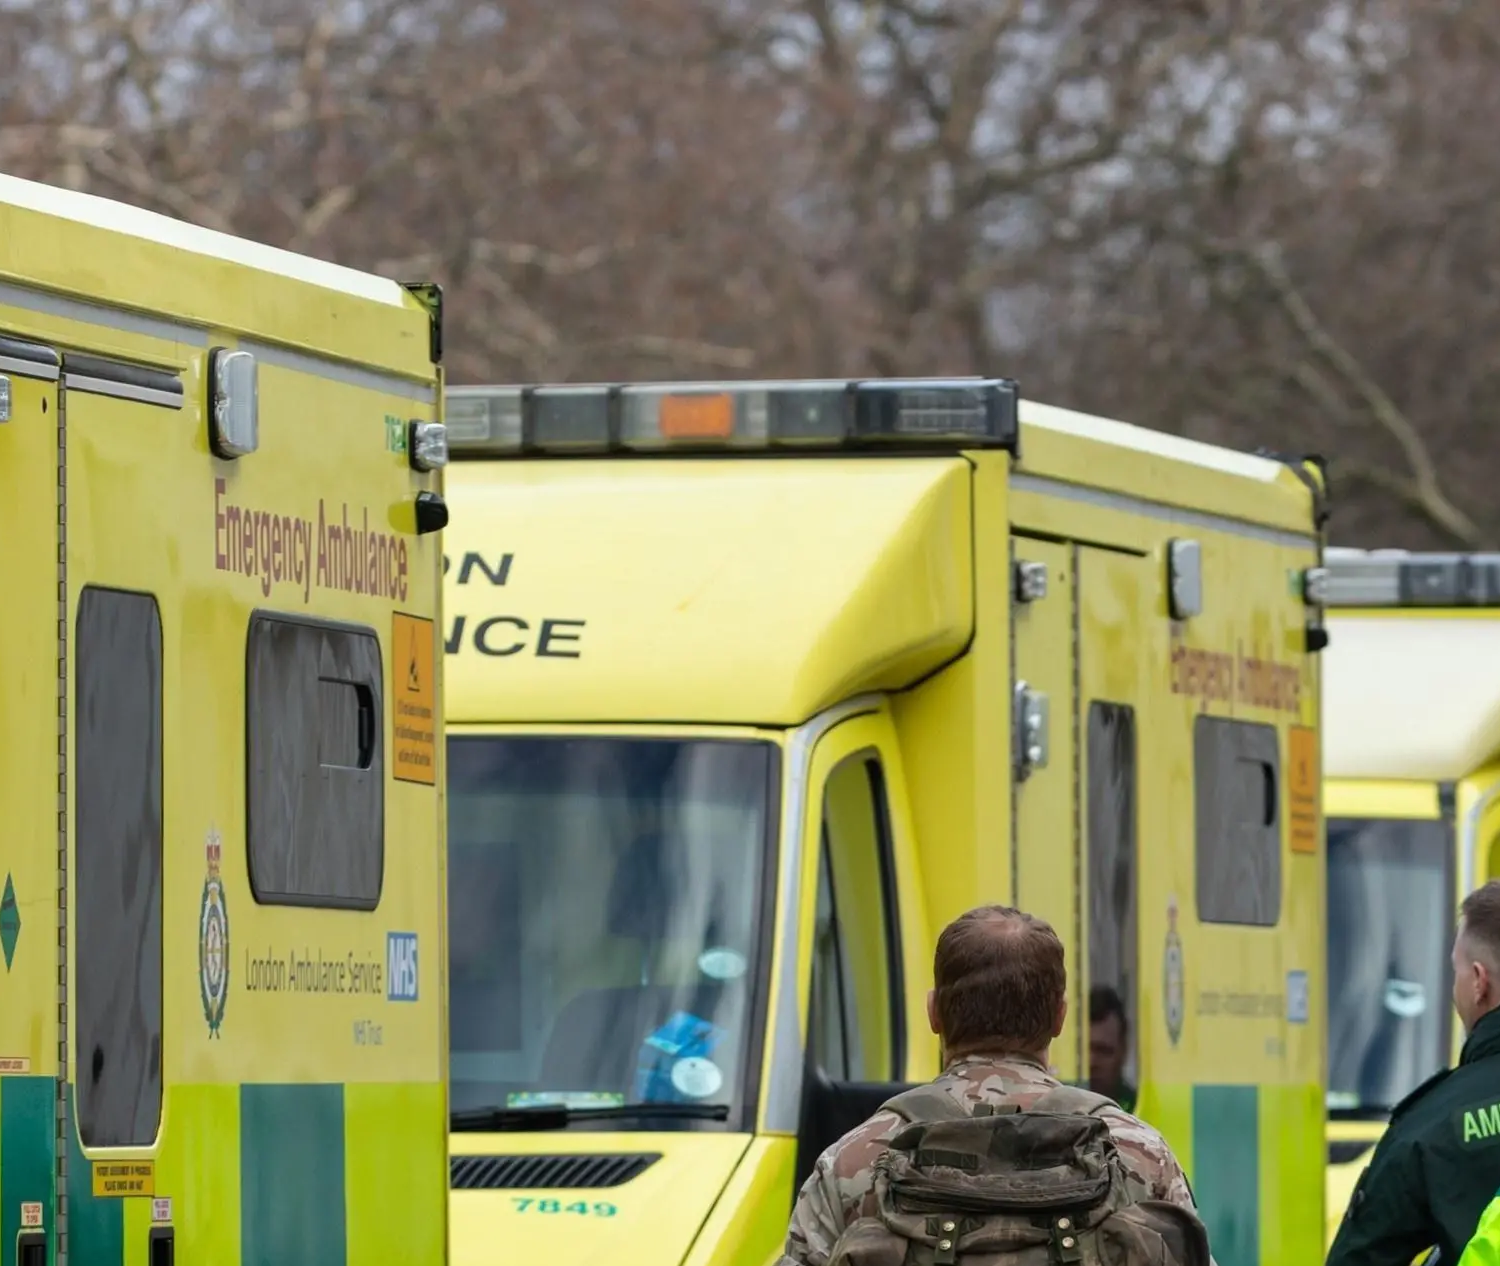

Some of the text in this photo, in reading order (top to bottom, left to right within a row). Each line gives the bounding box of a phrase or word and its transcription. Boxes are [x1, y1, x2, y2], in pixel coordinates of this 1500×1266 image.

[215, 478, 408, 603] Emergency Ambulance
[245, 944, 382, 994] London Ambulance Service
[388, 937, 417, 996] NHS
[510, 1197, 618, 1218] 7849
